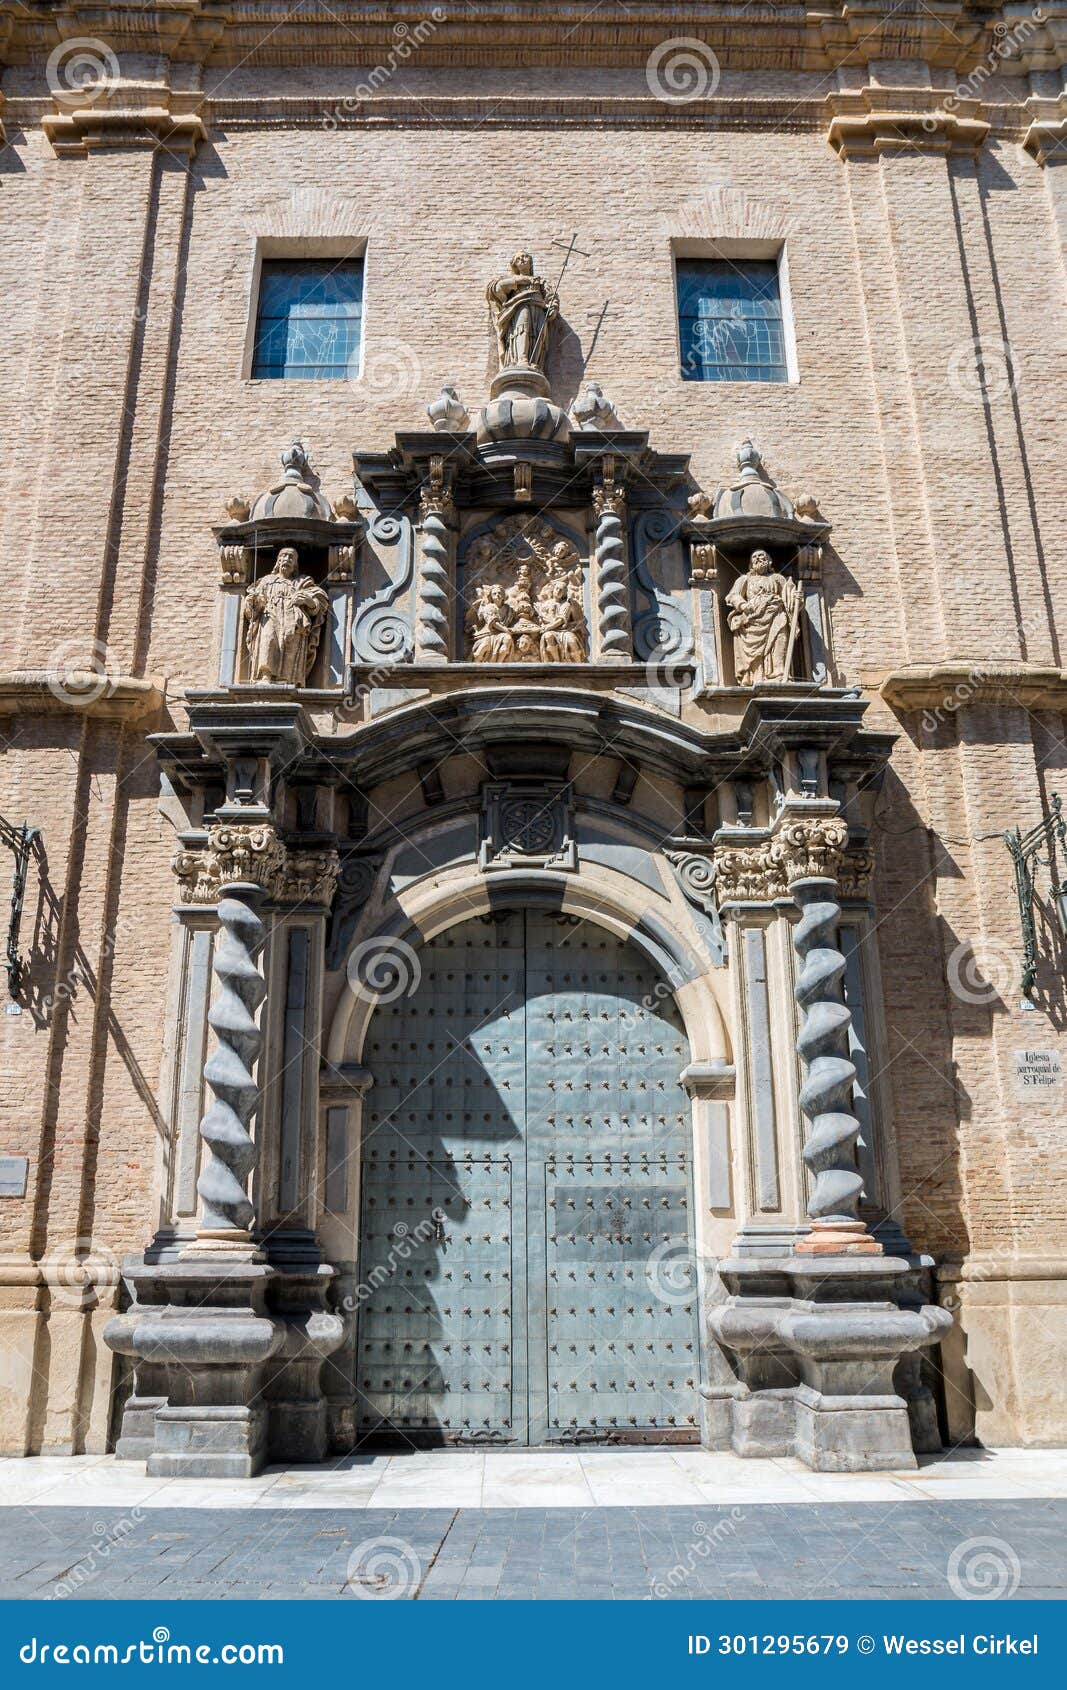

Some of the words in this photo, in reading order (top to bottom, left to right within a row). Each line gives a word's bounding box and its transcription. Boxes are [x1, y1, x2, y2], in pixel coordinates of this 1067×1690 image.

[1025, 1051, 1050, 1063] Iglesia
[1052, 1063, 1062, 1073] de
[1033, 1074, 1057, 1087] Felipe
